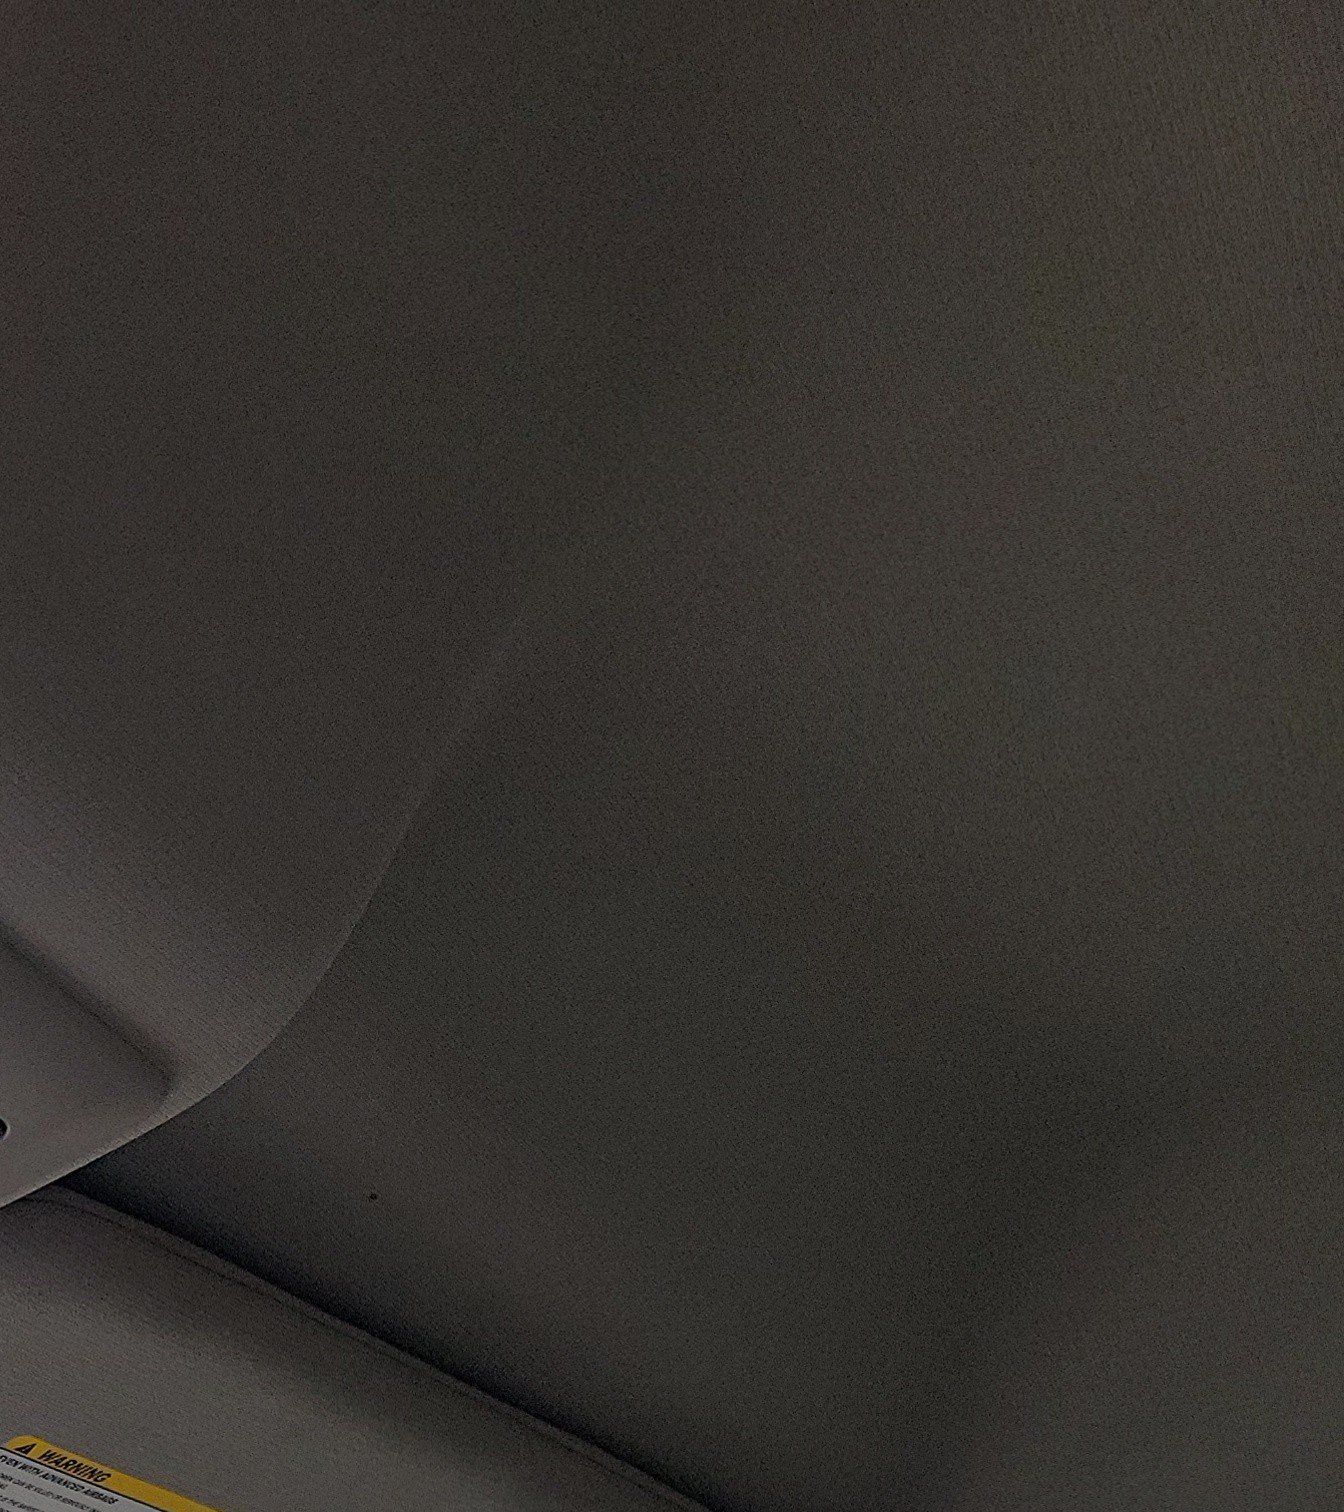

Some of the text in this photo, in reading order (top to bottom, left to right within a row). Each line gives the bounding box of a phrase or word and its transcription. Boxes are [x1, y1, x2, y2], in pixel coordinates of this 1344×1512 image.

[18, 1464, 42, 1475] WITH
[40, 1472, 85, 1491] ADVANCED
[82, 1489, 119, 1504] AIRBAGS
[37, 1450, 111, 1482] WARNING
